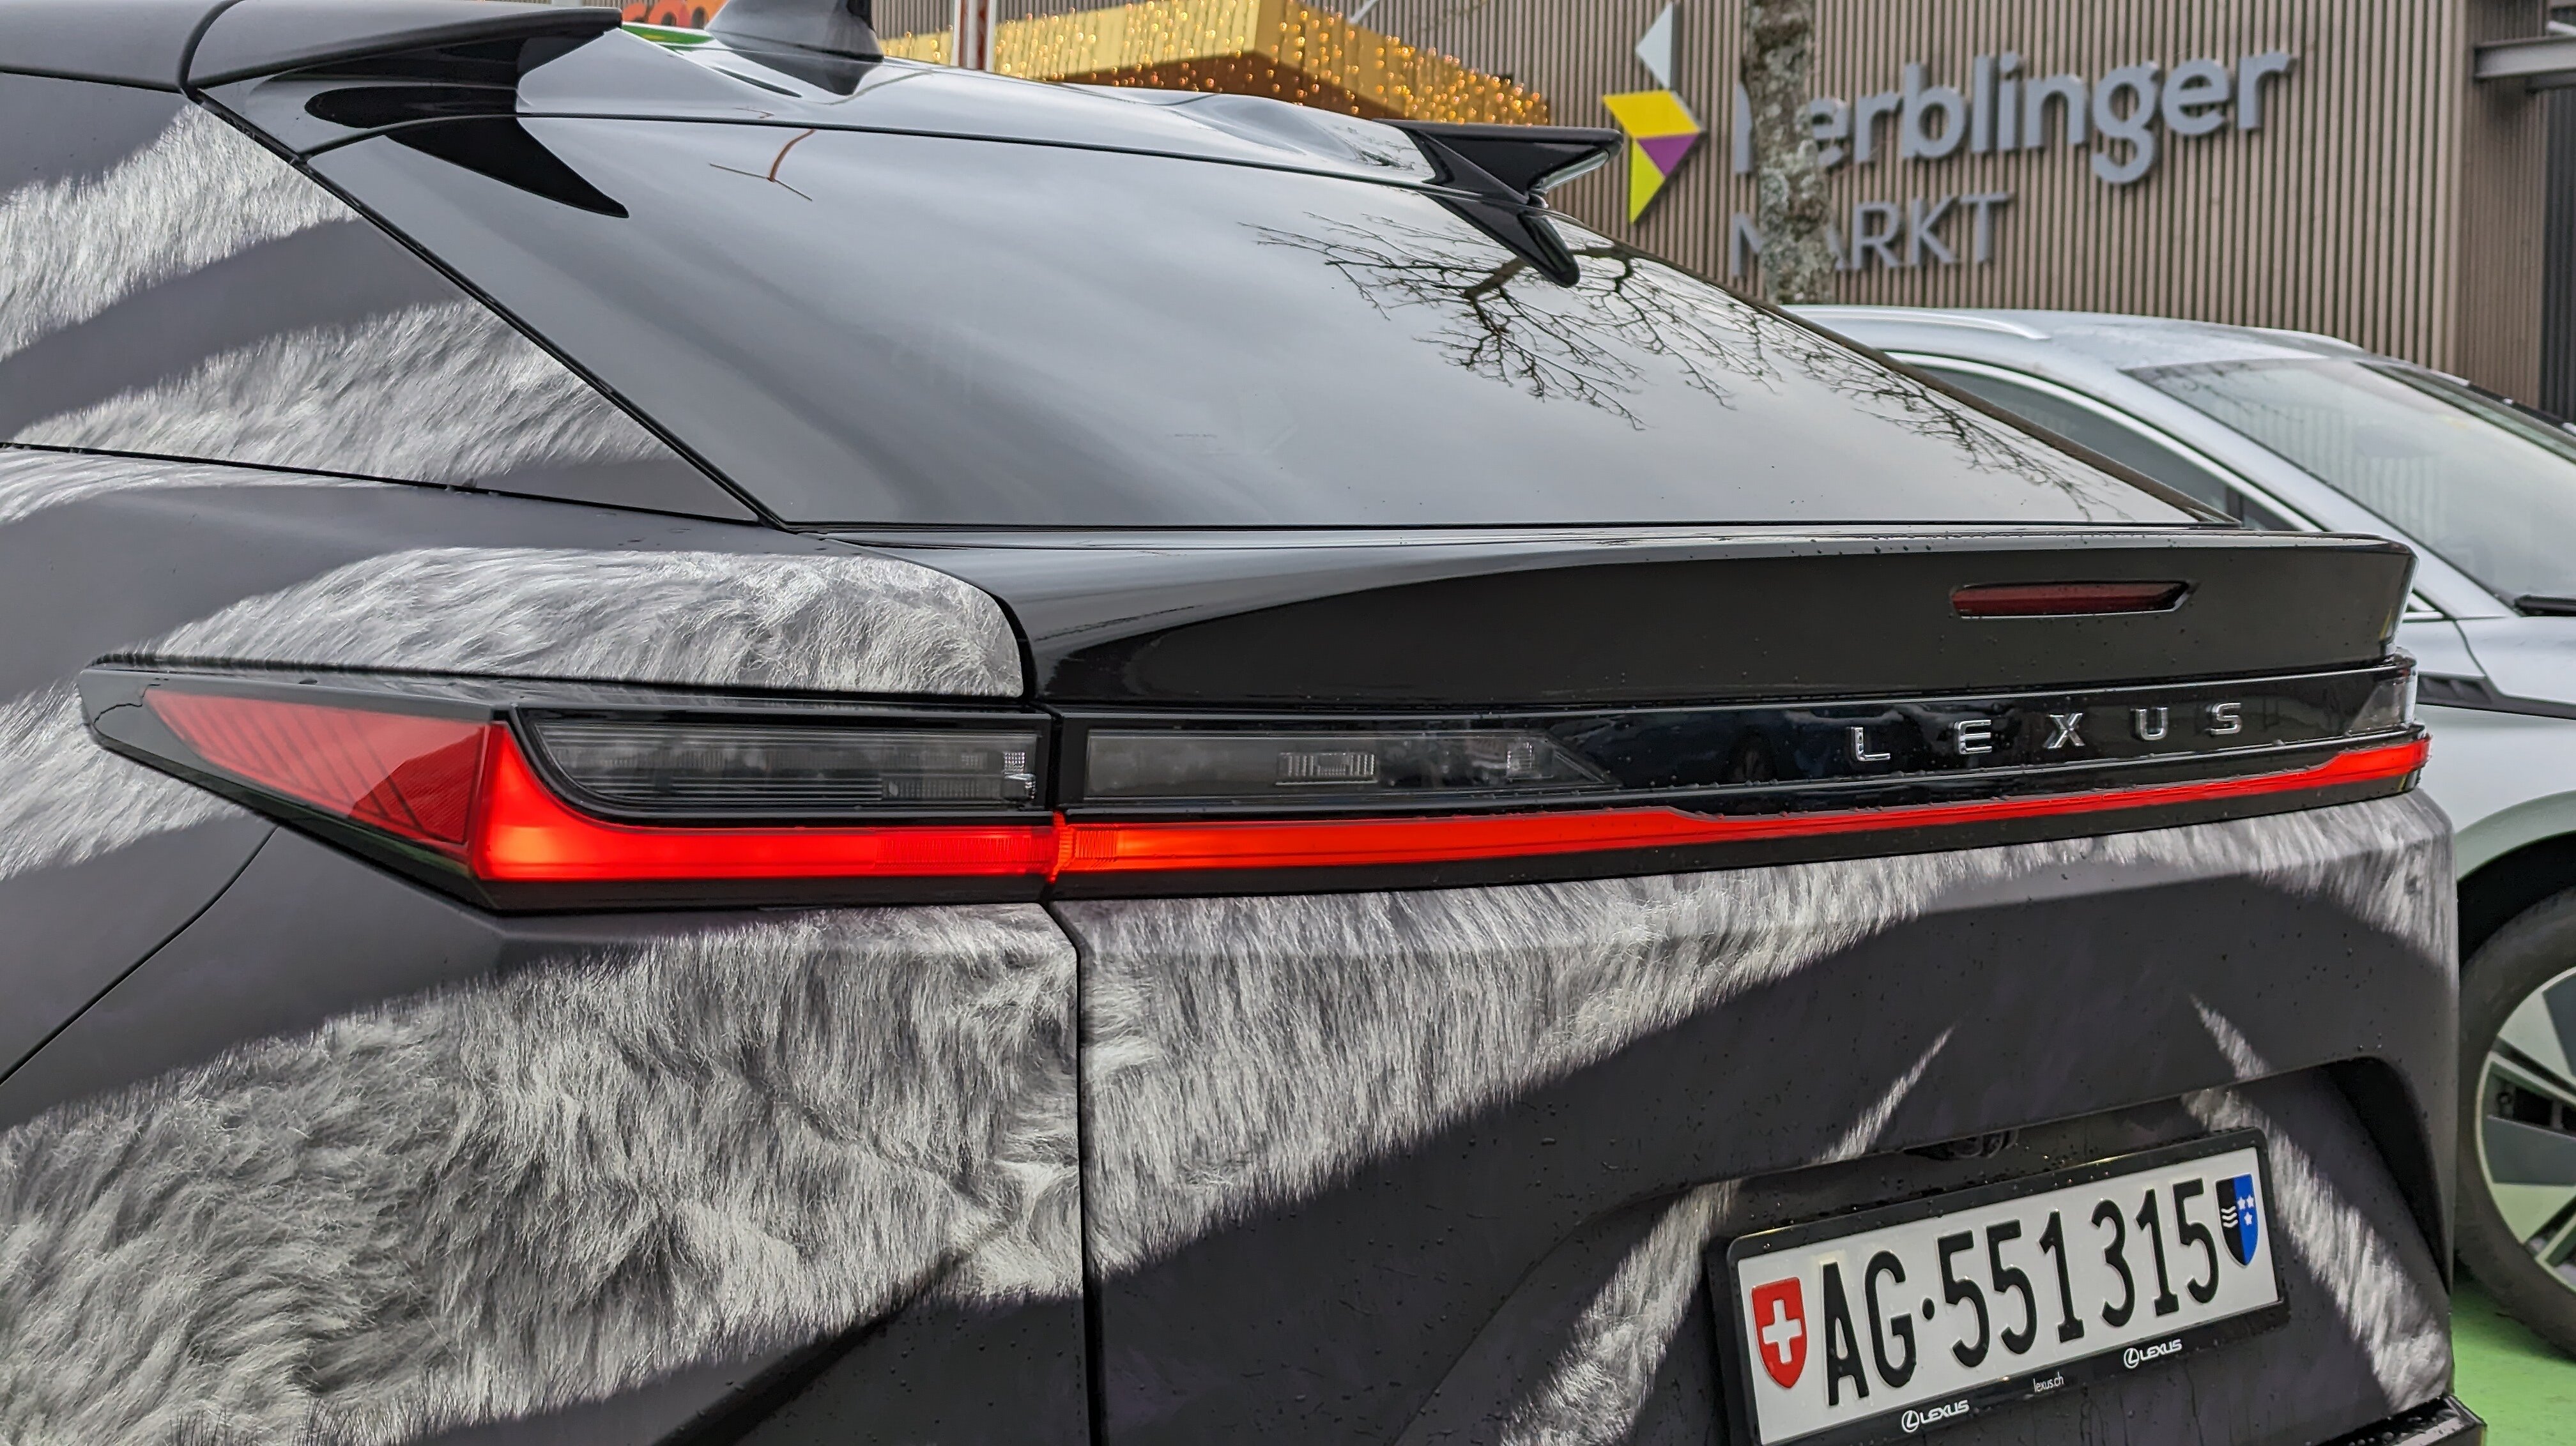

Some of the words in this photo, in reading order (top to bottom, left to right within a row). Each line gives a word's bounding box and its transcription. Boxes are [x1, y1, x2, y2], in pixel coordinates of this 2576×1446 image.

[1851, 702, 2242, 762] LEXUS
[2140, 1338, 2183, 1362] LEXUS
[1920, 1399, 1970, 1424] LEXUS
